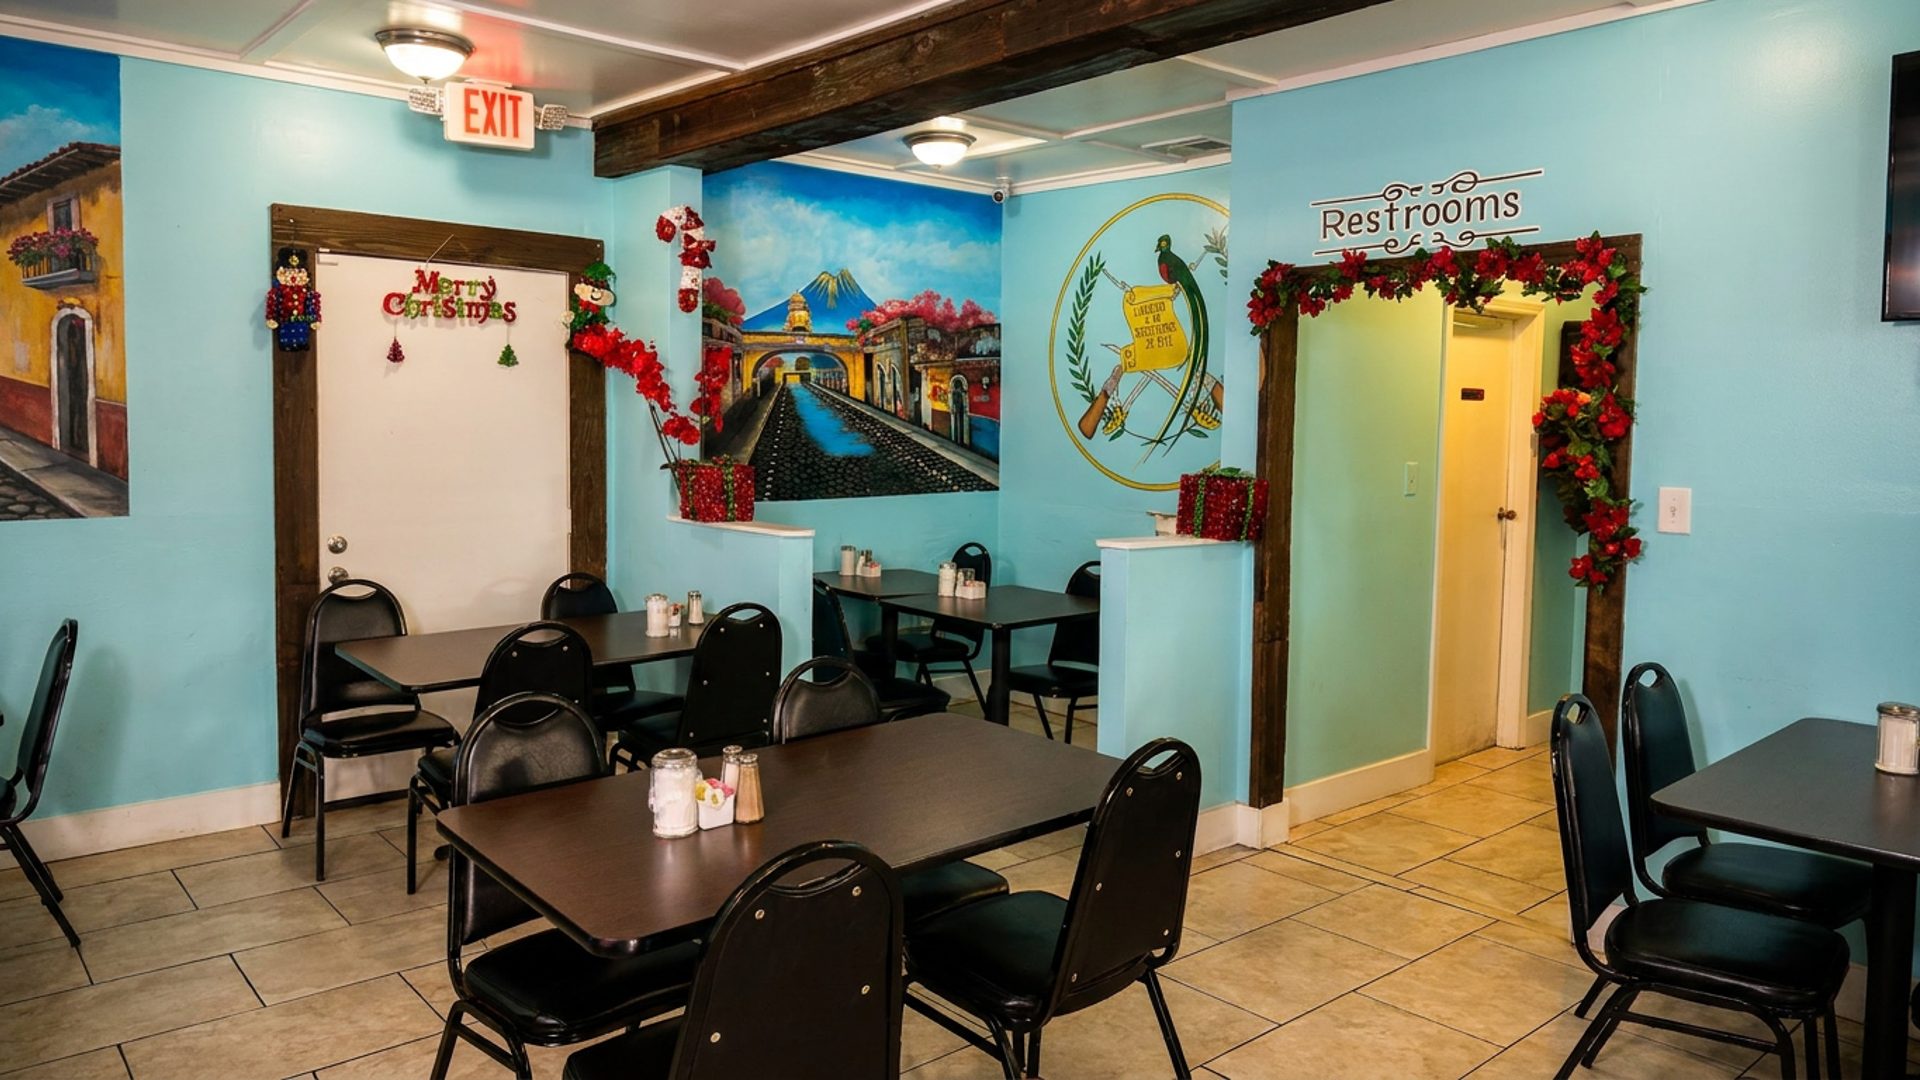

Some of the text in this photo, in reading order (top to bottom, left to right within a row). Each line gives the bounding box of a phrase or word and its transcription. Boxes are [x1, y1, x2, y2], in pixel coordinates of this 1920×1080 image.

[464, 88, 523, 138] EXIT
[1322, 191, 1519, 239] Restrooms
[412, 269, 497, 301] Merry
[383, 292, 516, 323] Christmas
